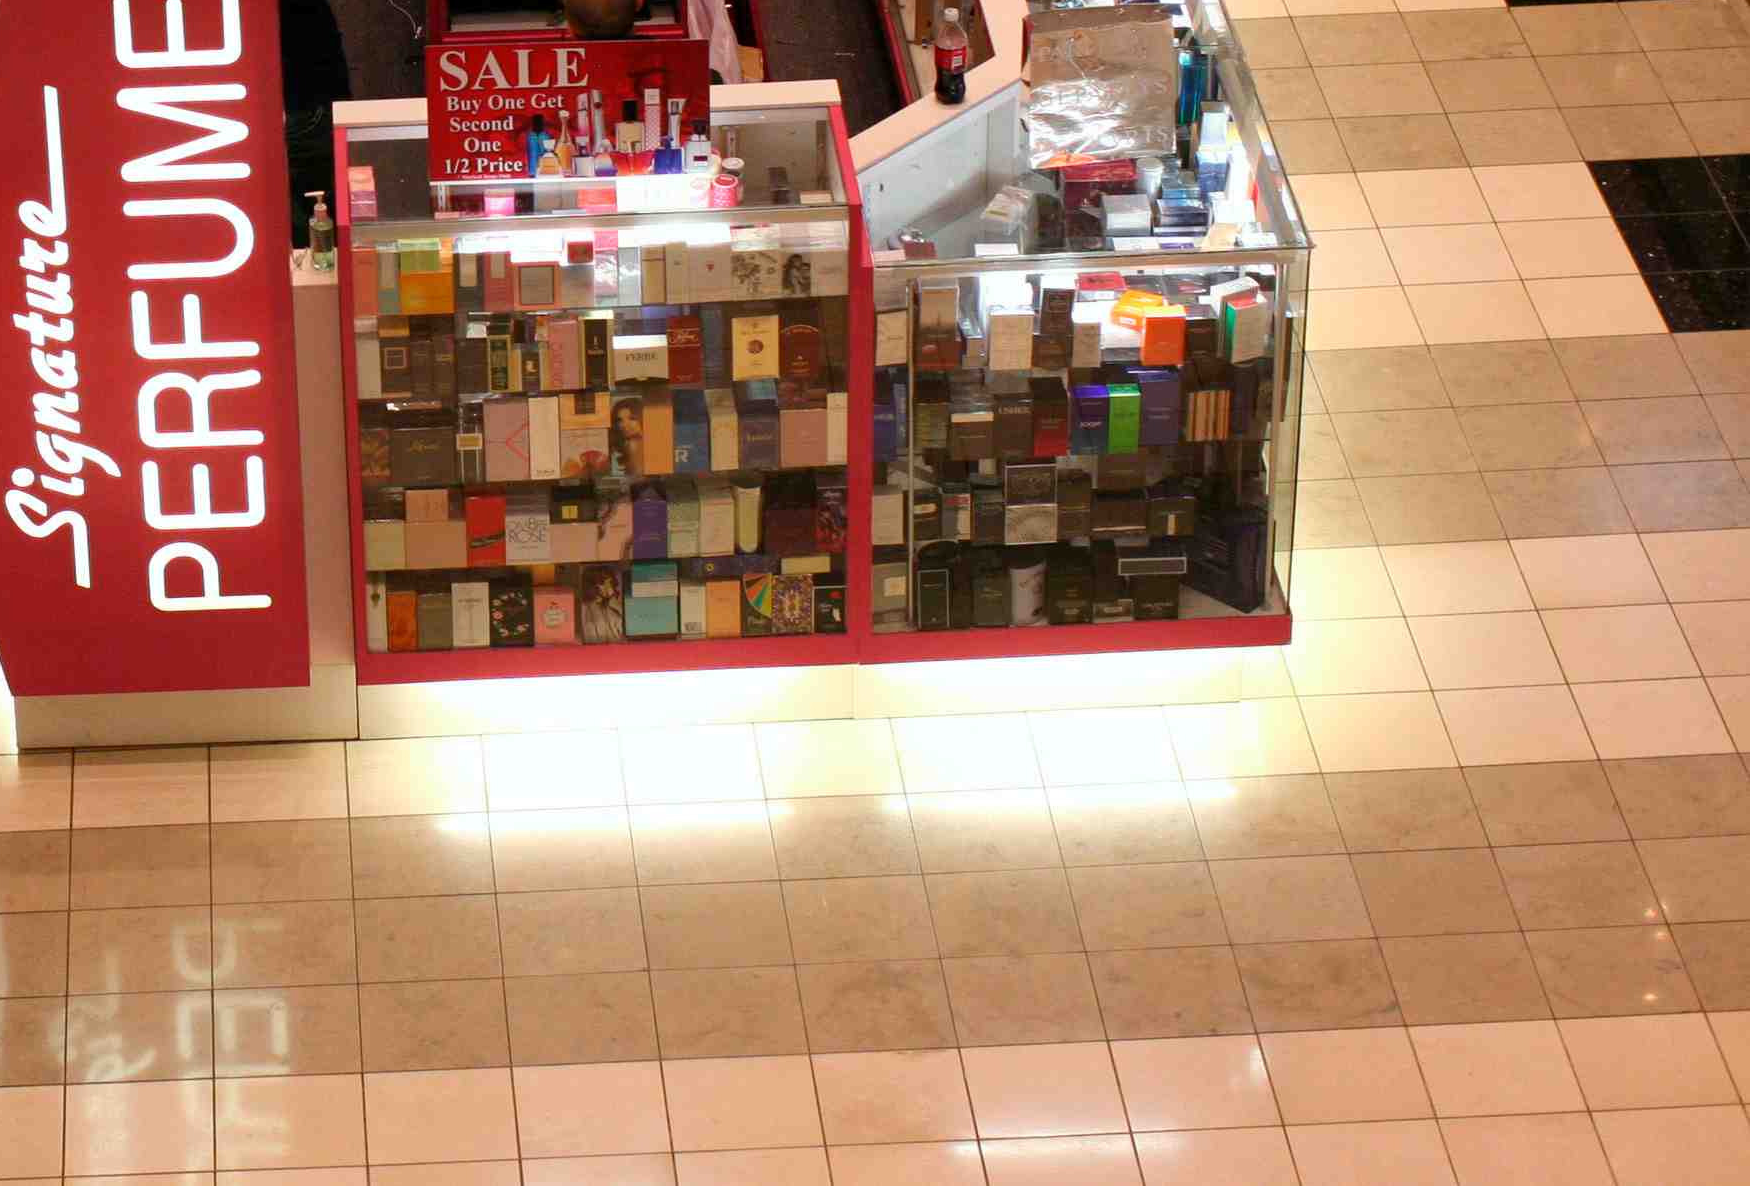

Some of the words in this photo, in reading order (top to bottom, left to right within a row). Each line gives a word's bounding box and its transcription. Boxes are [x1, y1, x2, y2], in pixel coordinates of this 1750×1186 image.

[439, 47, 589, 91] SALE
[447, 96, 482, 114] Buy
[487, 94, 525, 110] One
[530, 92, 564, 109] Get
[449, 115, 514, 132] Second
[463, 137, 502, 152] One
[444, 158, 470, 174] 1/2
[475, 157, 523, 173] Price
[5, 85, 122, 588] Signature
